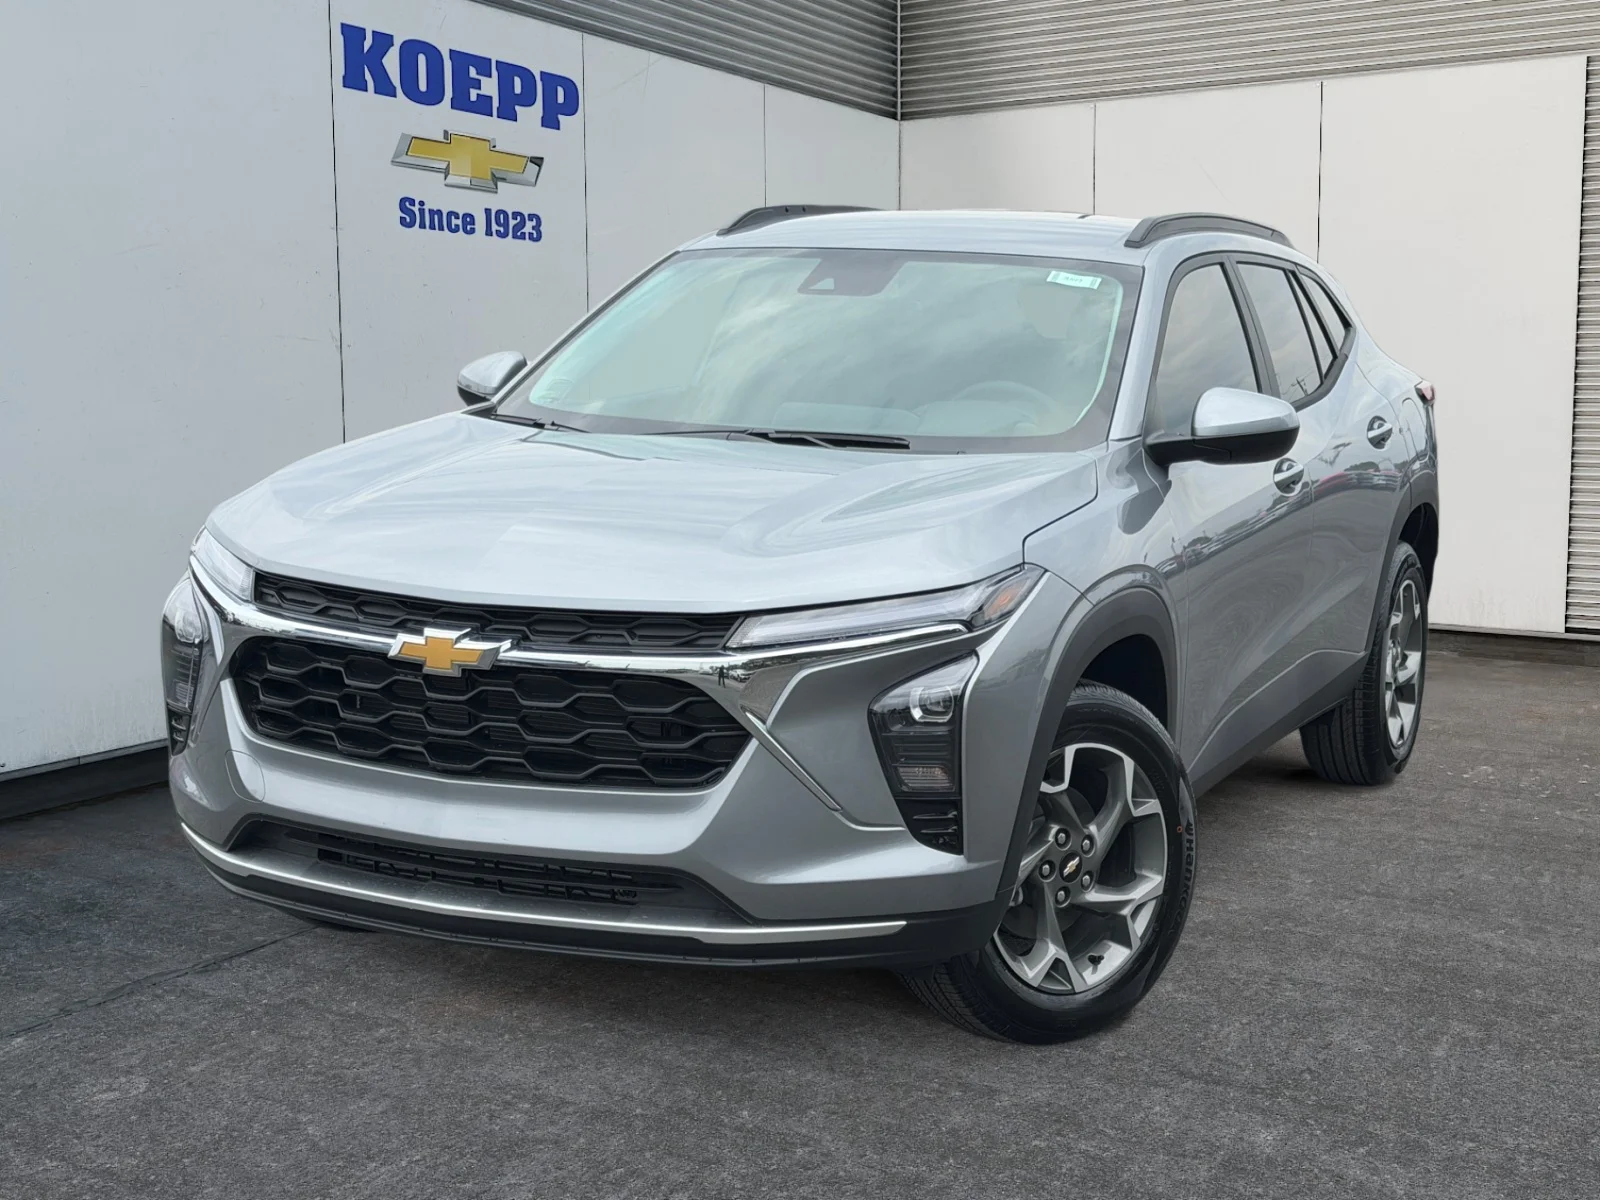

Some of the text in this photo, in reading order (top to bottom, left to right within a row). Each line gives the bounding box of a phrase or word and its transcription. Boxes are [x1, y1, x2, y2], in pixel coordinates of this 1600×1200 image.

[340, 22, 580, 130] KOEPP
[398, 196, 543, 243] Since 1923
